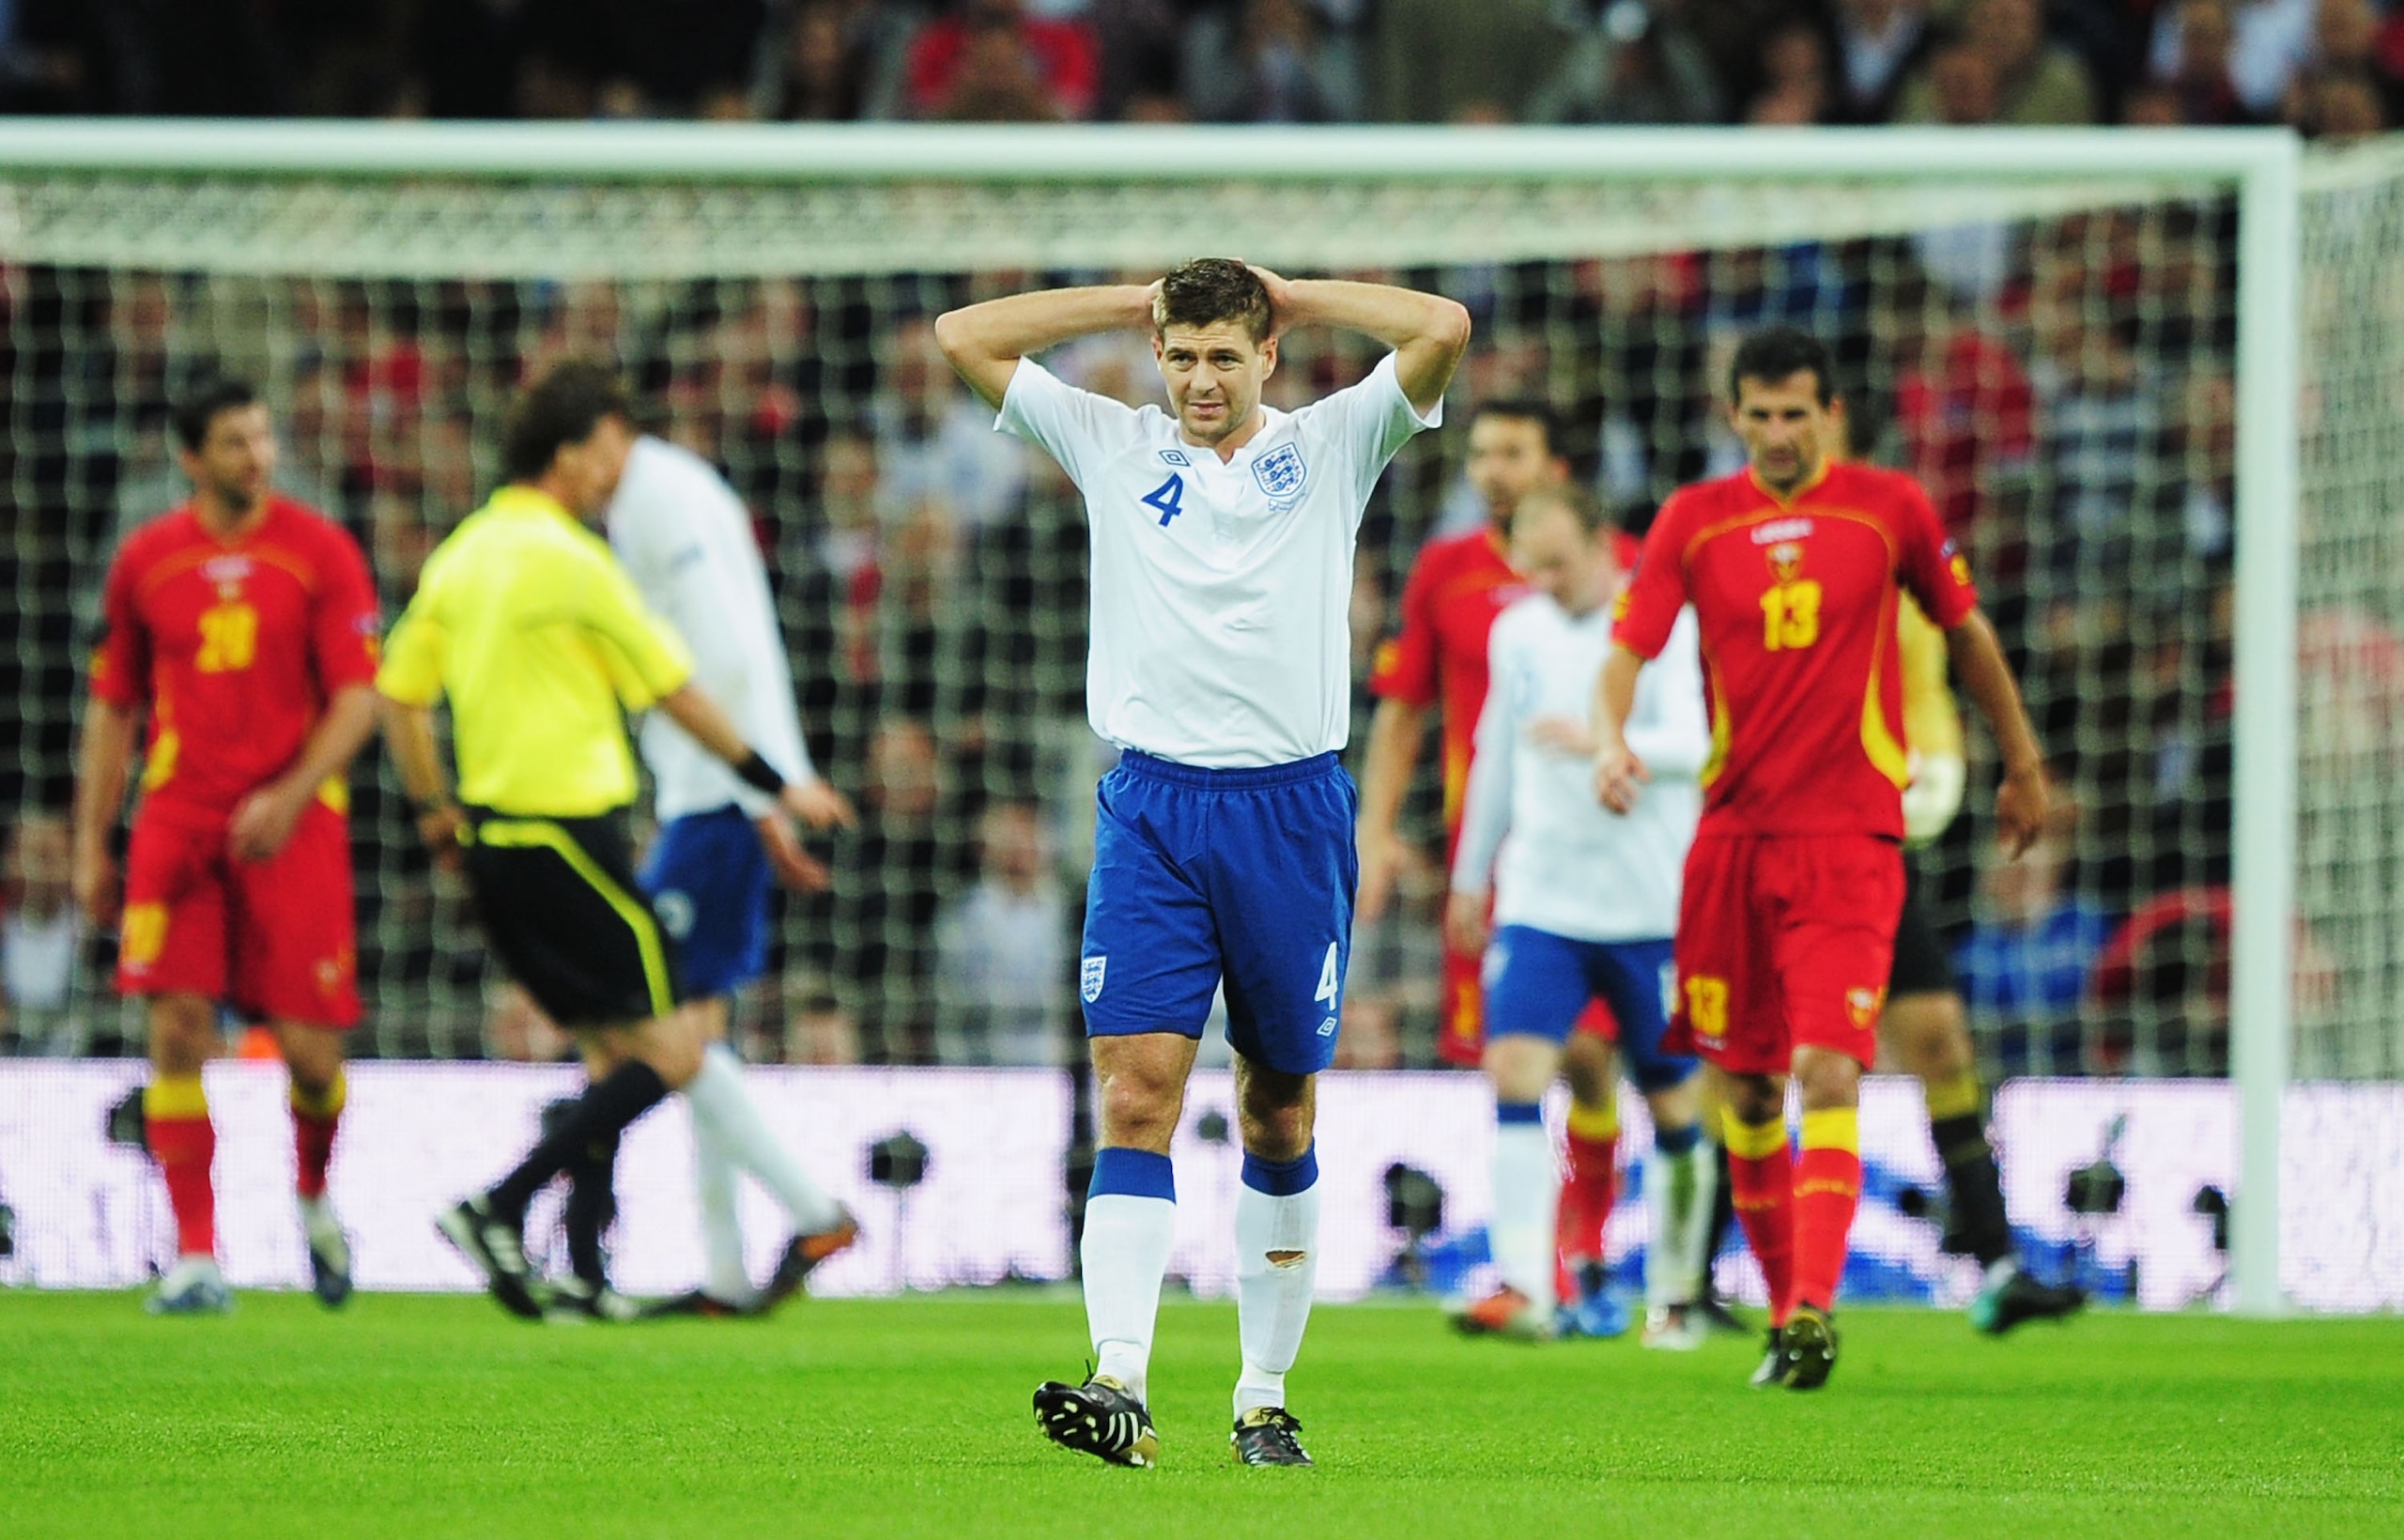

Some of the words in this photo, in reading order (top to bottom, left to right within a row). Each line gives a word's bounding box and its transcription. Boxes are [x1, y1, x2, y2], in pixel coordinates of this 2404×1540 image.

[1141, 471, 1183, 527] 4
[196, 605, 256, 672] 20
[1760, 579, 1821, 650] 13
[1315, 941, 1337, 1011] 4
[1686, 974, 1729, 1036] 13
